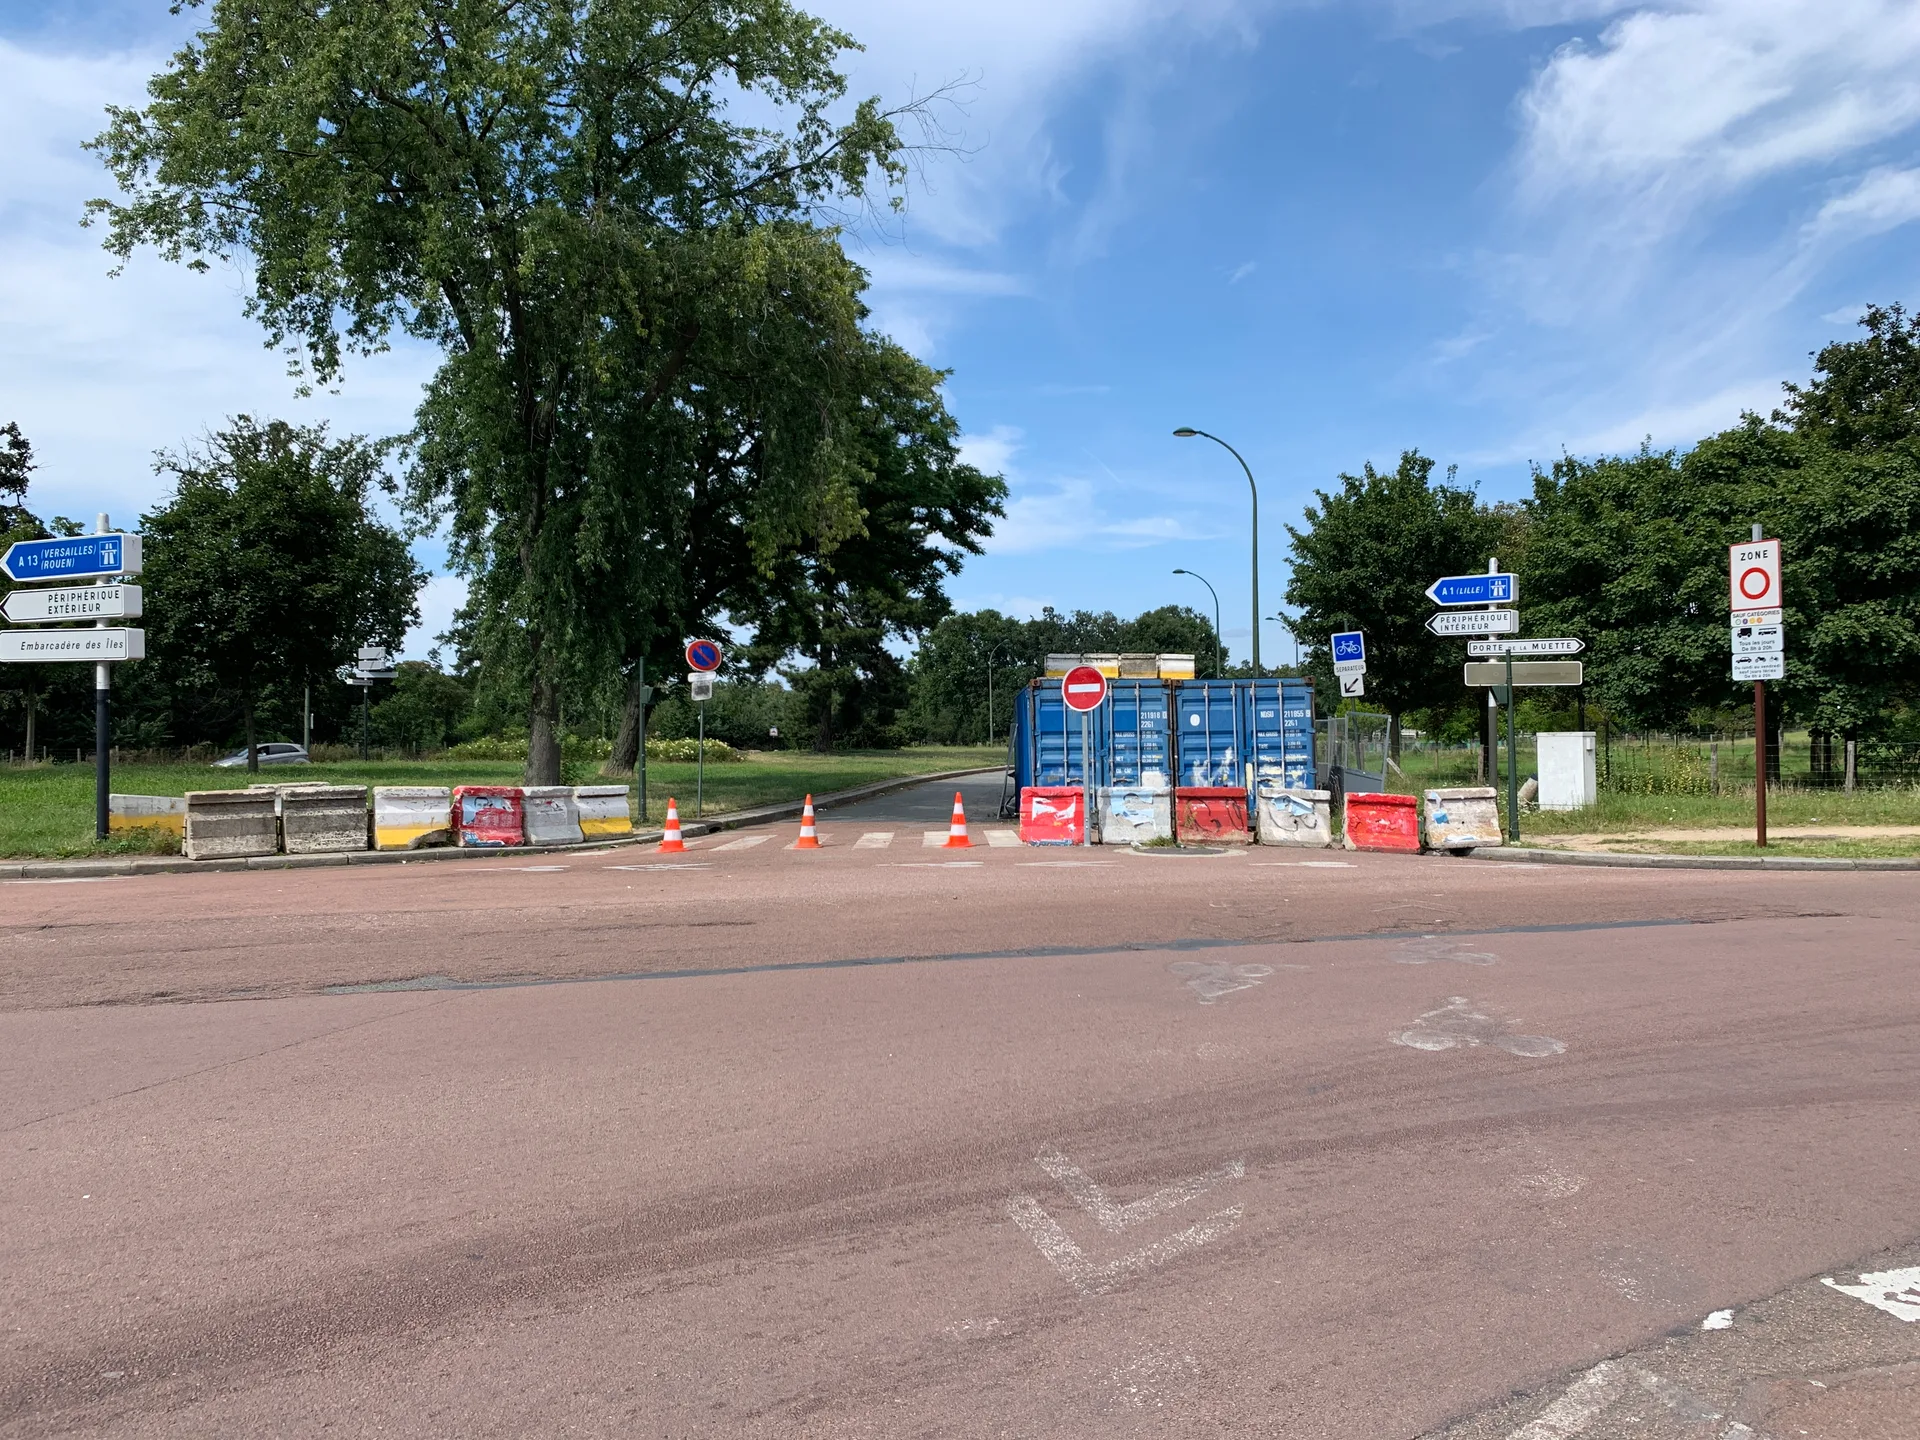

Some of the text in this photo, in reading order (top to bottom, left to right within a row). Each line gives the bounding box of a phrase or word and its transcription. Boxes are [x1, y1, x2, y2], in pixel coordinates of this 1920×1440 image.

[18, 544, 96, 567] A 13 (VERSAILLES)
[1740, 550, 1768, 562] ZONE
[40, 558, 75, 570] (ROUEN)
[48, 590, 120, 603] PÉRIPHÉRIQUE
[1442, 587, 1448, 596] A
[1456, 585, 1484, 595] (LILLE)
[48, 603, 101, 615] EXTÉRIEUR
[1440, 613, 1508, 623] PÉRIPHÉRIQUE
[1440, 623, 1489, 632] INTÉRIEUR
[20, 638, 124, 651] Embarcadère des Îles
